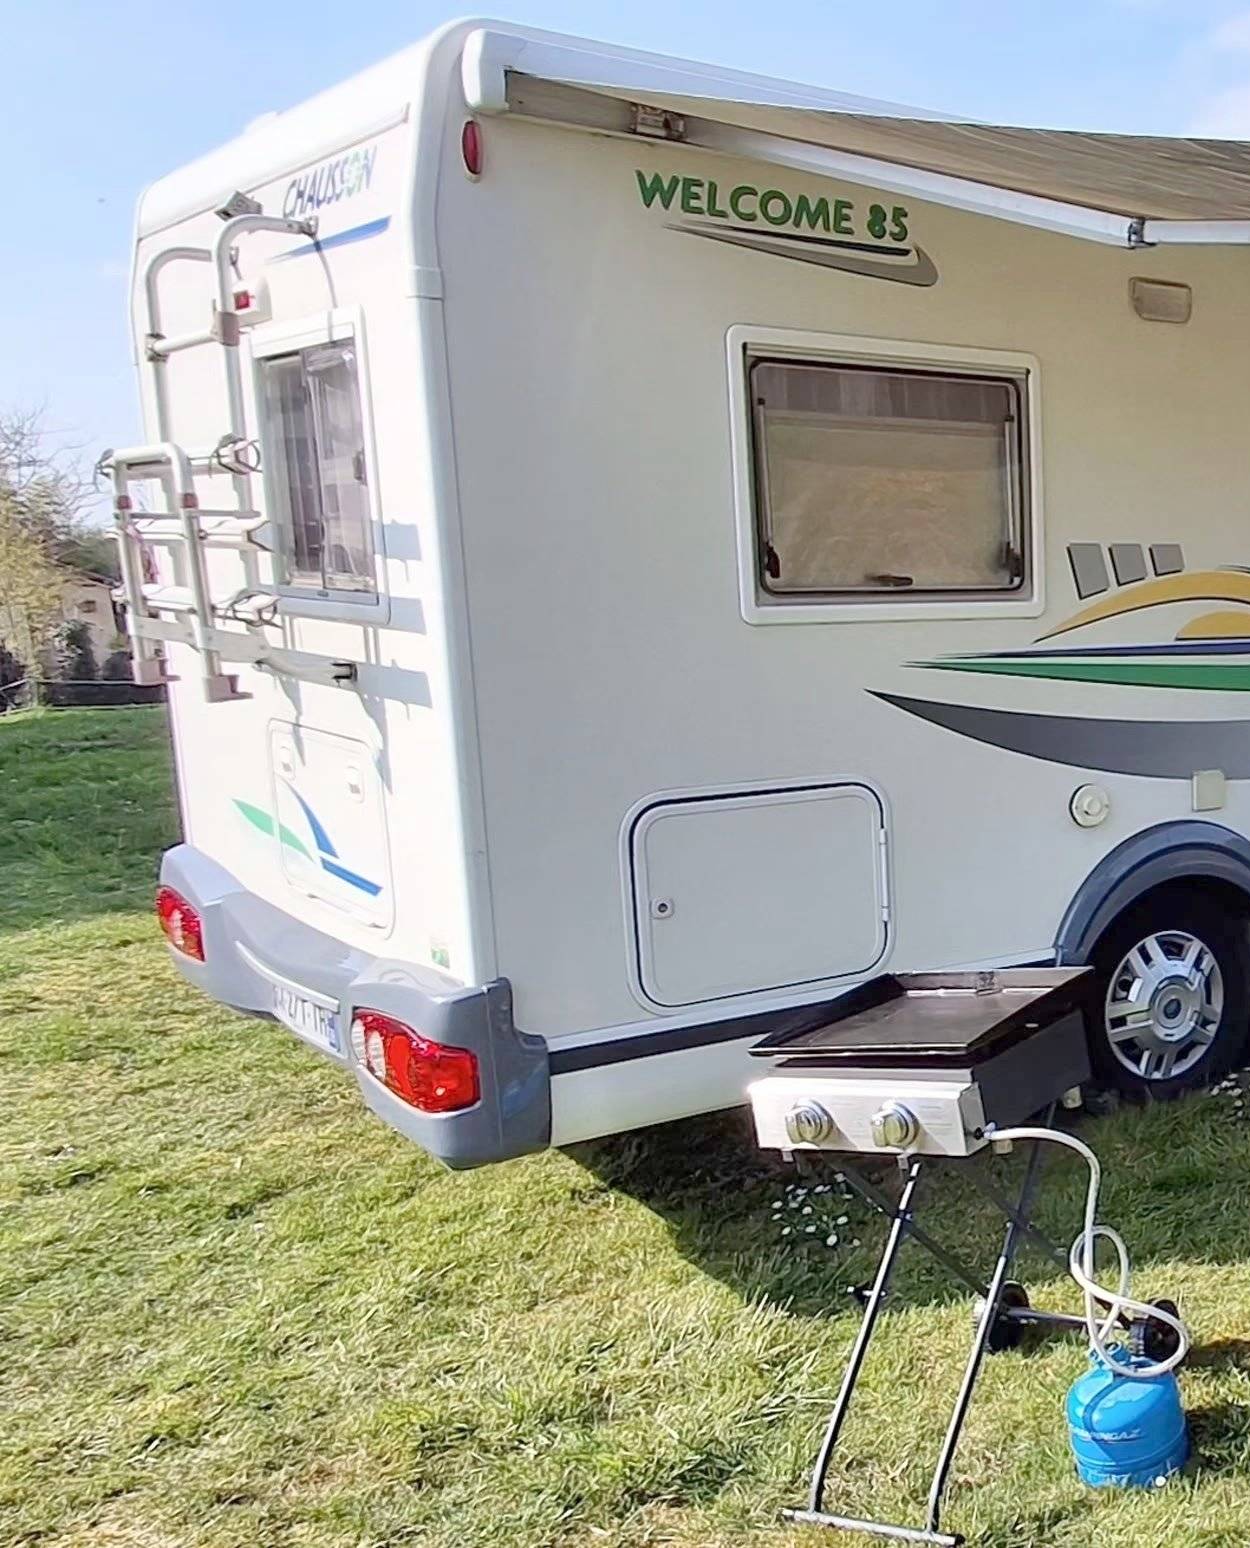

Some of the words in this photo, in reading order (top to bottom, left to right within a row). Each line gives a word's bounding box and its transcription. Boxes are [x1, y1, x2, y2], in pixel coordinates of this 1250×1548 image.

[283, 145, 377, 218] CHAUSSON
[635, 170, 854, 235] WELCOME
[866, 204, 909, 241] 85
